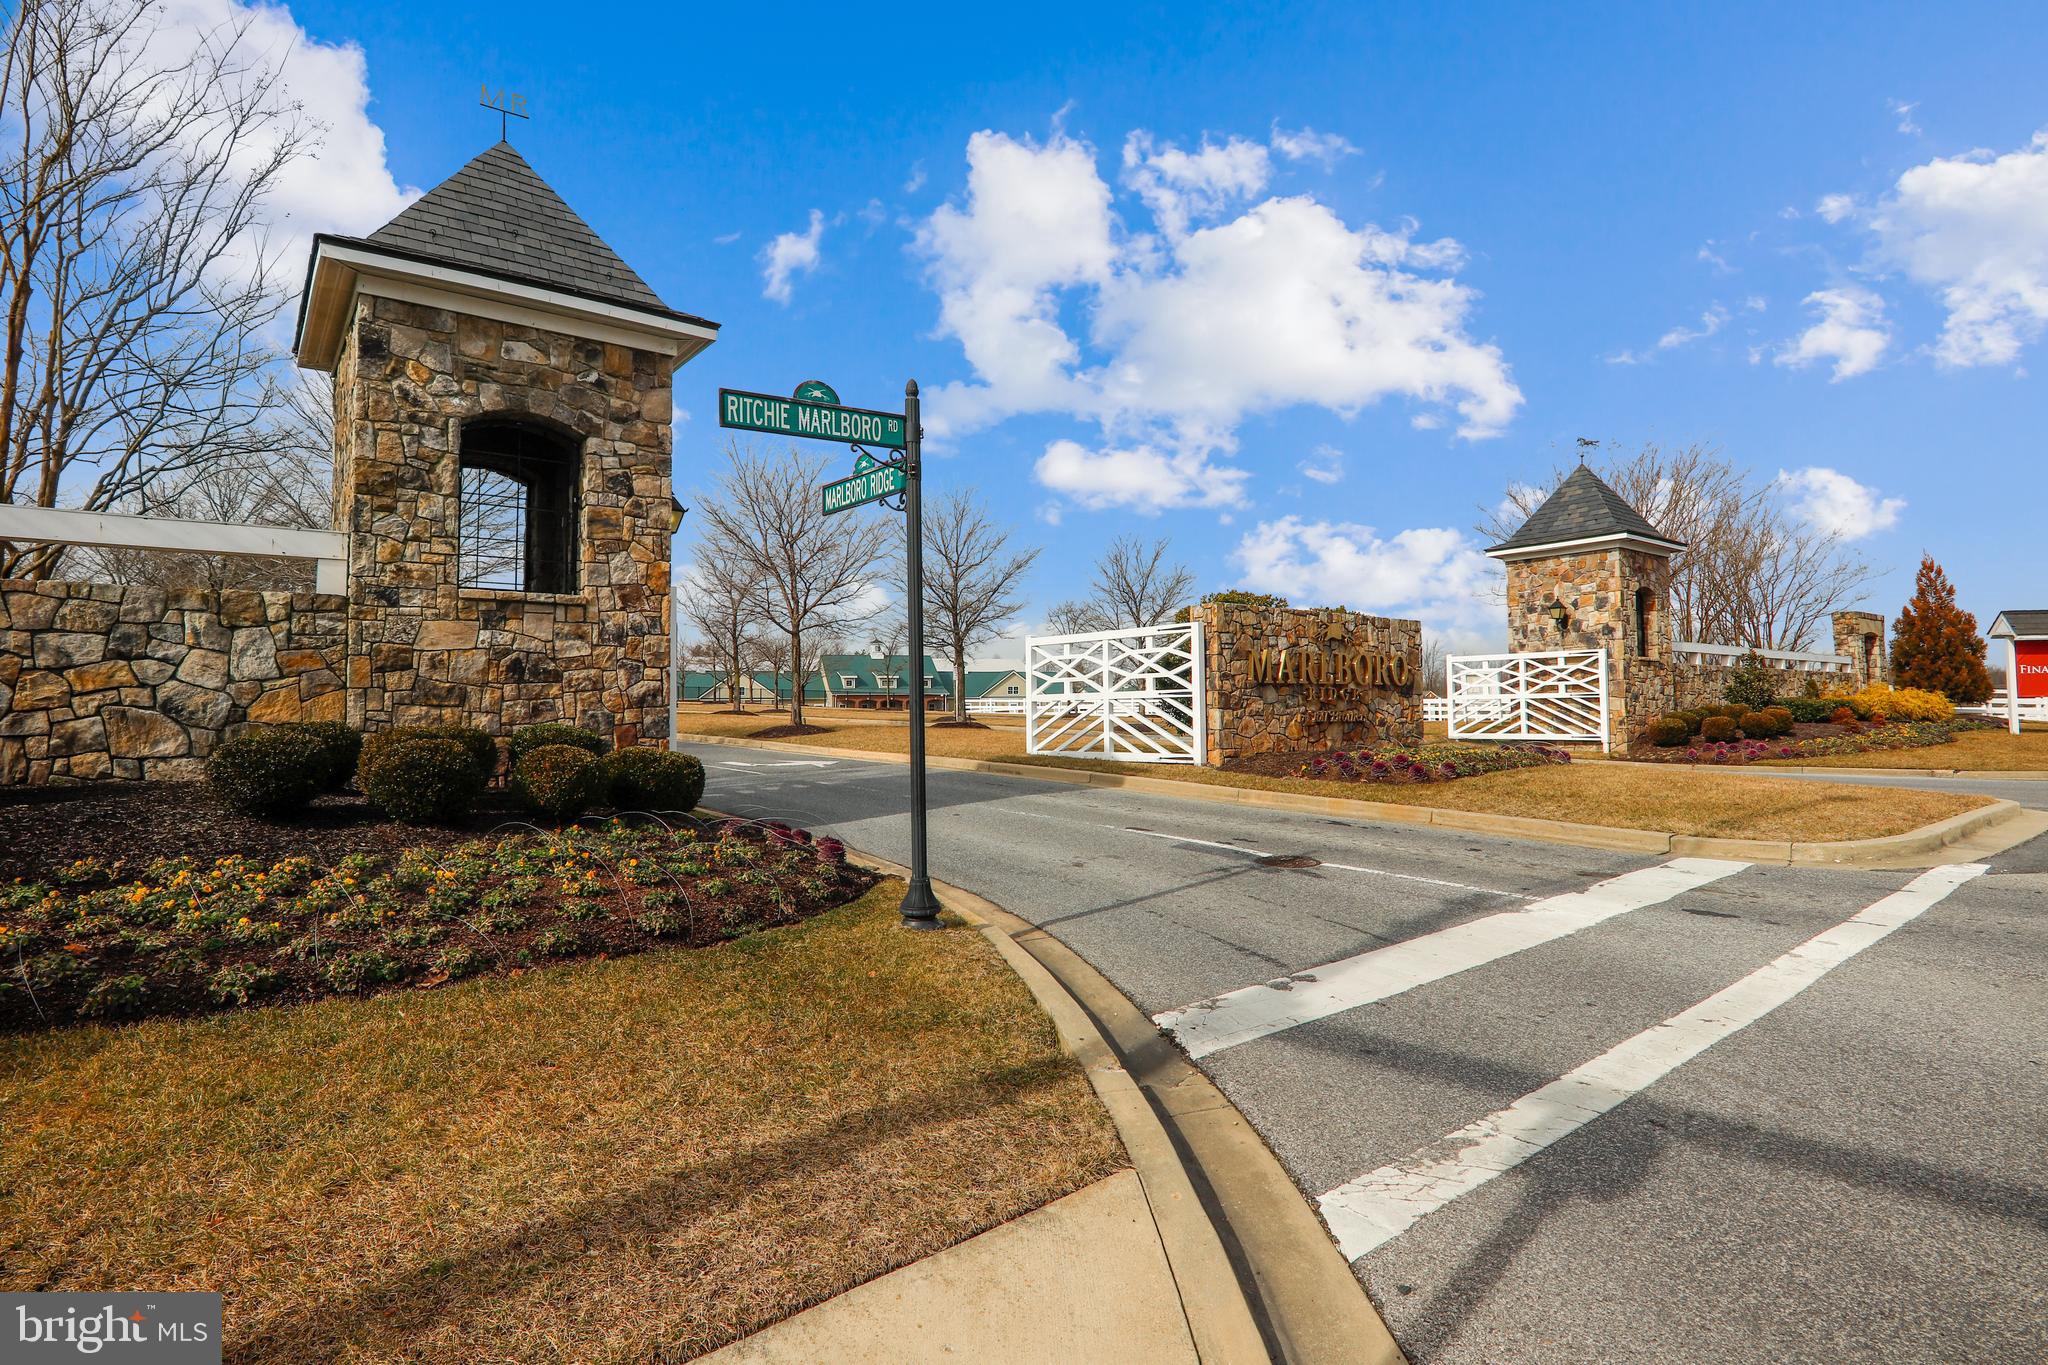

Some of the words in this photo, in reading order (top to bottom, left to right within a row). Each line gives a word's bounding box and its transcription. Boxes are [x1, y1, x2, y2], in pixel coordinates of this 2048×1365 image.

[727, 396, 791, 429] RITCHIE
[798, 406, 882, 442] MARLBORO
[888, 419, 898, 433] RD
[825, 476, 867, 510] MARLBORO
[870, 467, 895, 496] RIDGE
[1248, 649, 1409, 687] MARLBORO
